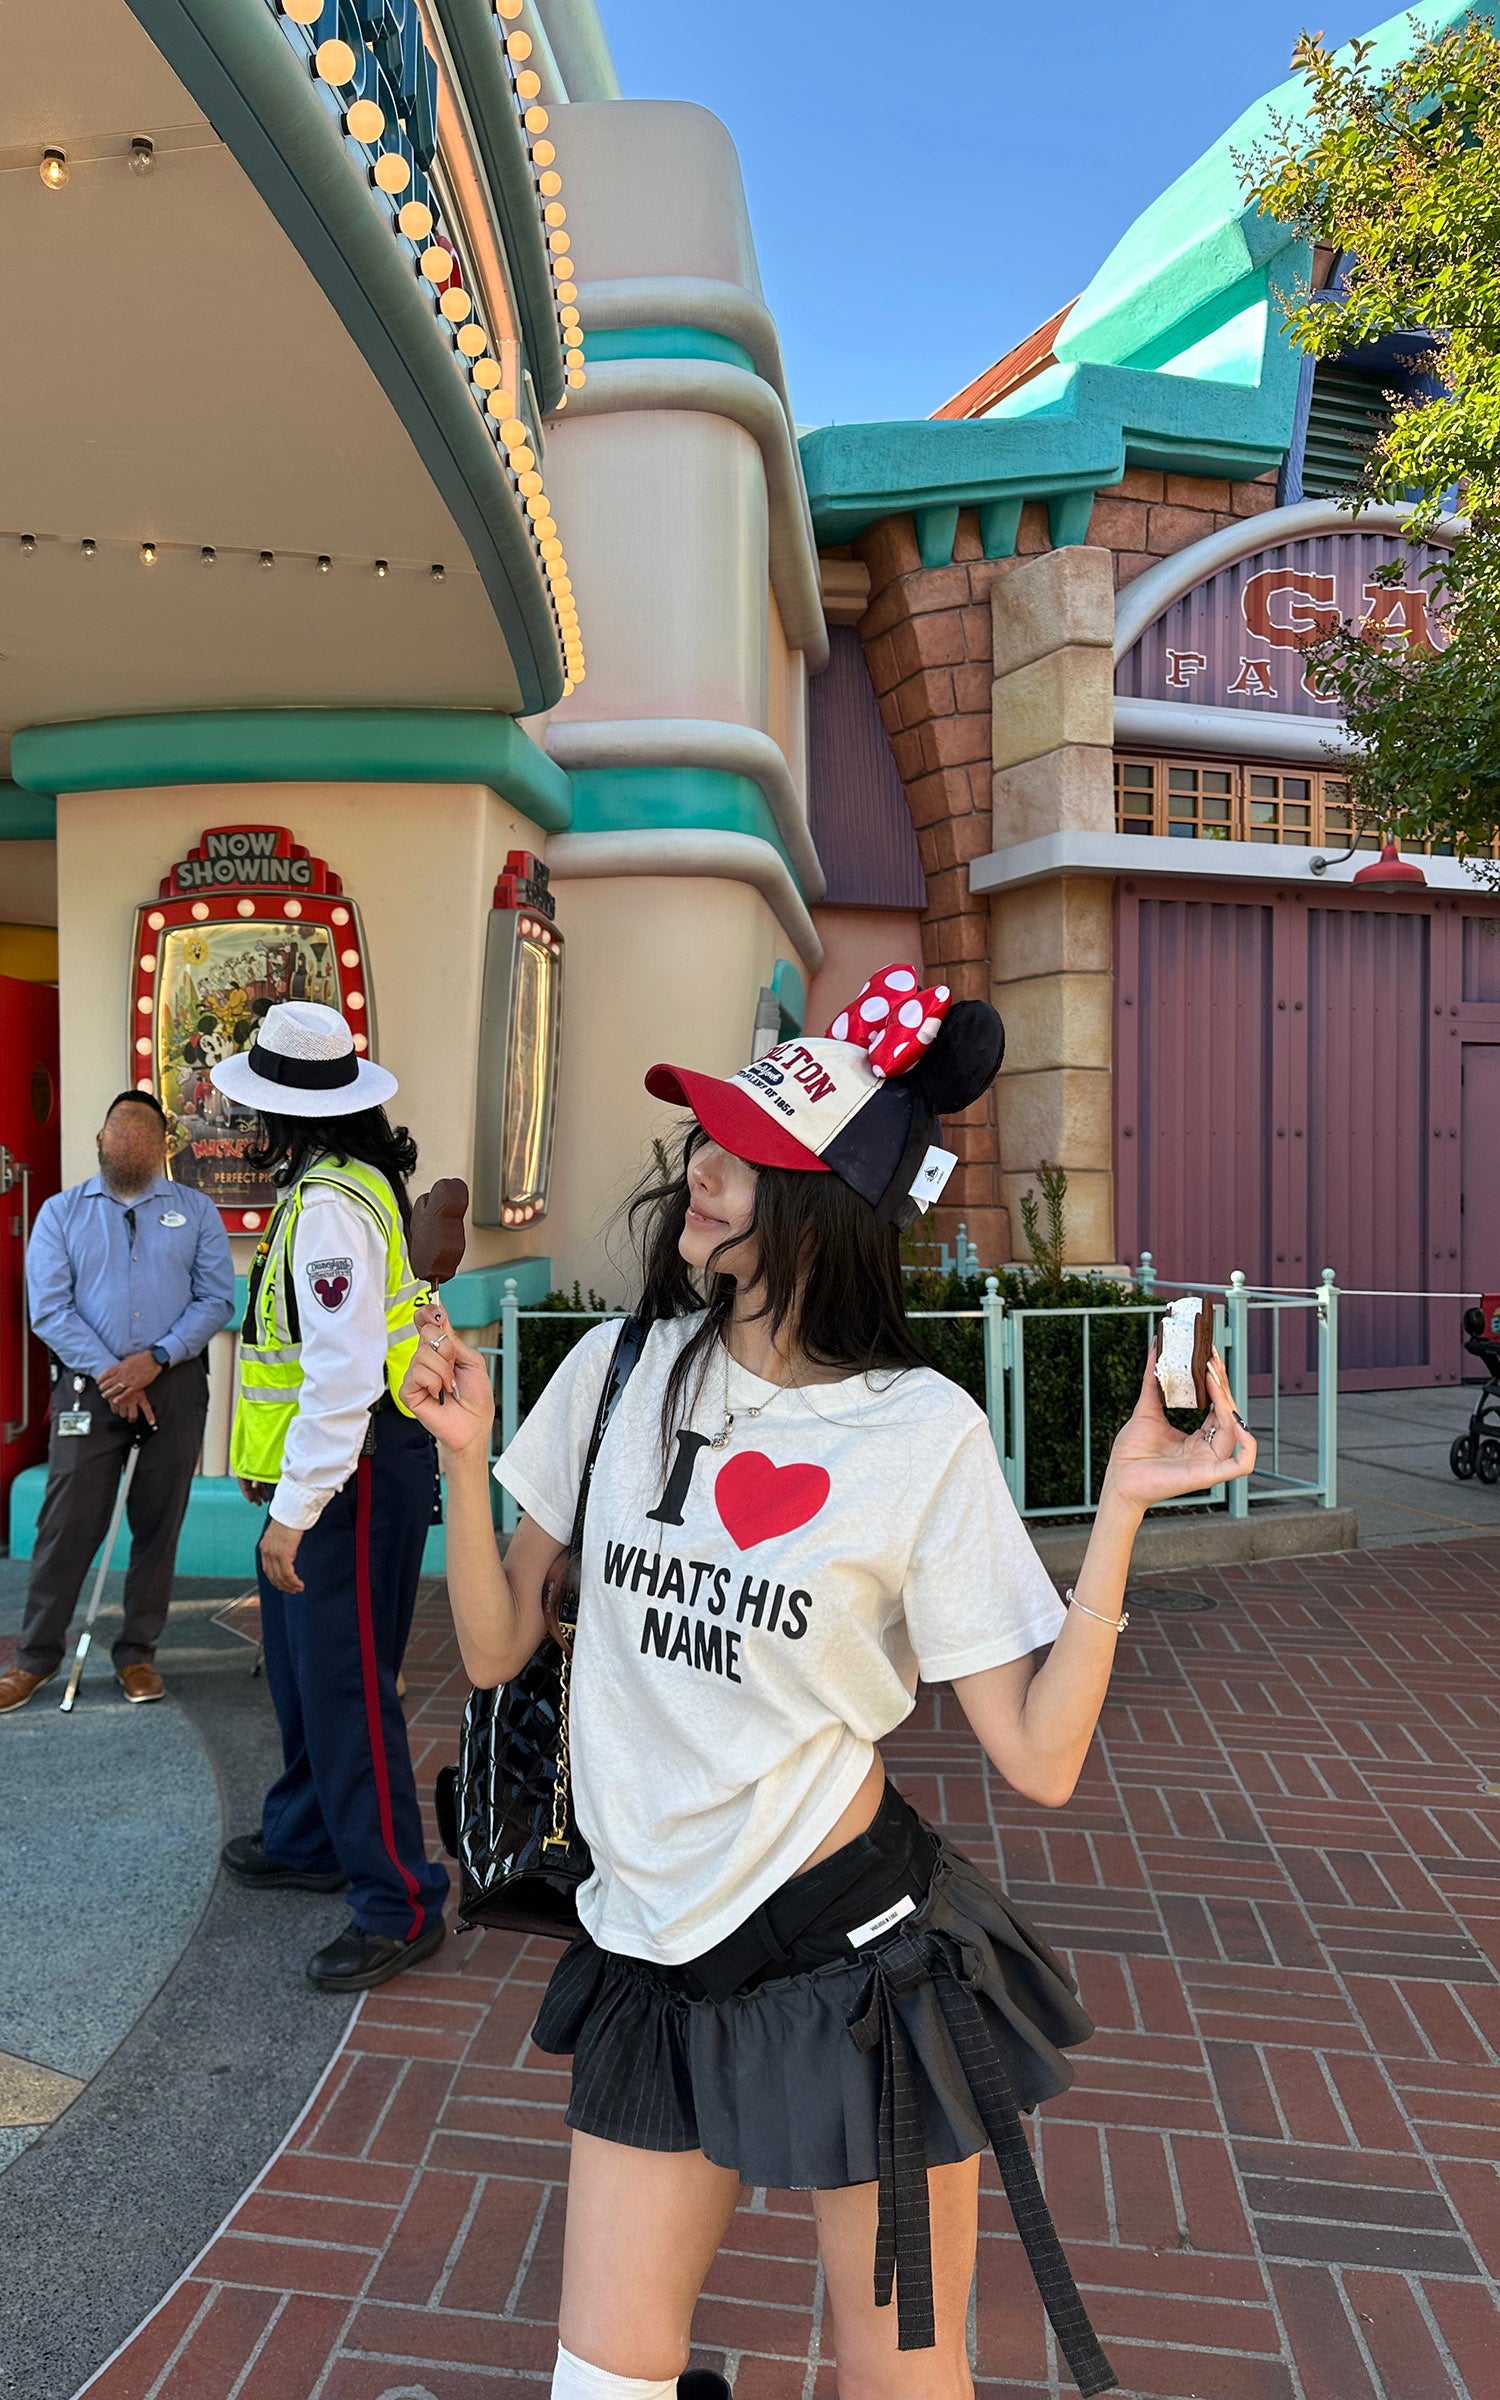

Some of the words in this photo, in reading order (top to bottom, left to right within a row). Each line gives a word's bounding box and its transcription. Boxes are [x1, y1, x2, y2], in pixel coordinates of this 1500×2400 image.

[206, 832, 277, 858] NOW
[176, 858, 312, 888] SHOWING
[764, 1087, 778, 1098] OF
[214, 1172, 257, 1184] PERFECT
[646, 1429, 711, 1527] I
[736, 1575, 813, 1640] HIS
[640, 1607, 742, 1684] NAME
